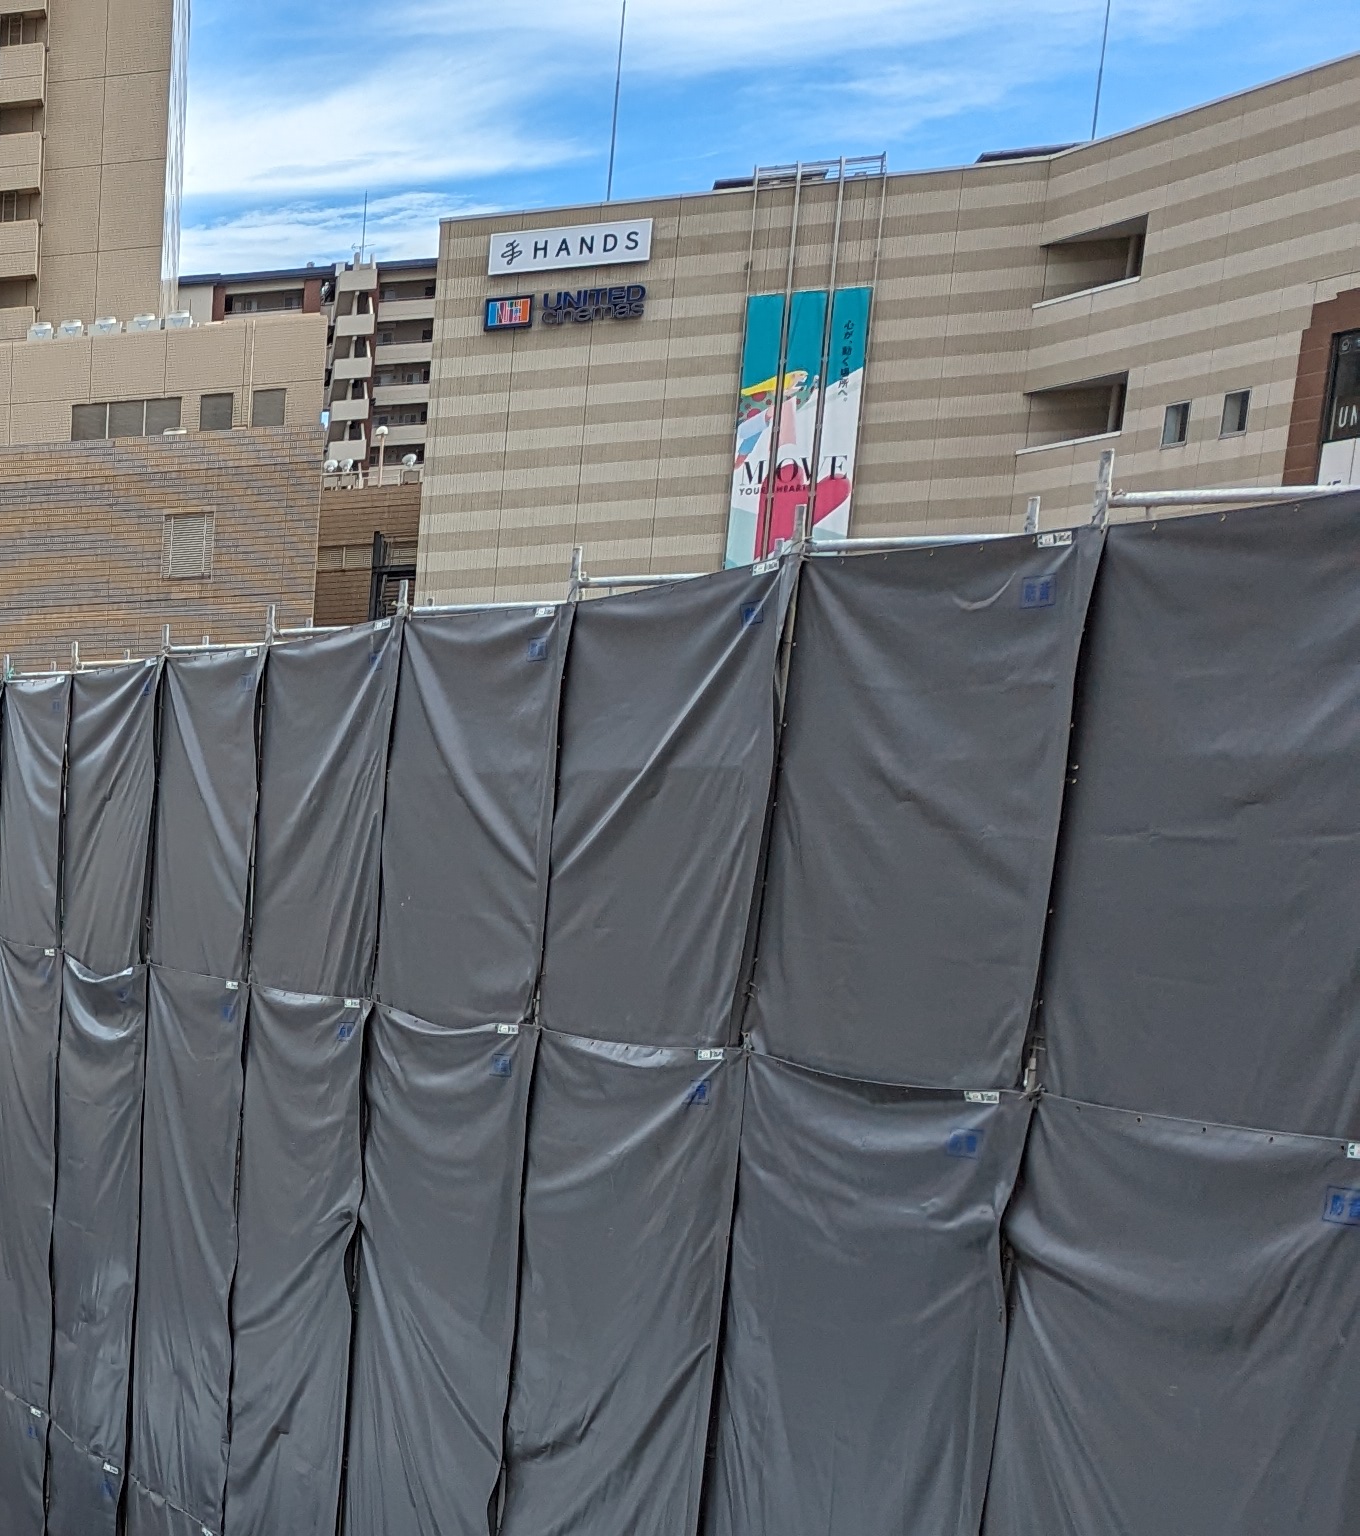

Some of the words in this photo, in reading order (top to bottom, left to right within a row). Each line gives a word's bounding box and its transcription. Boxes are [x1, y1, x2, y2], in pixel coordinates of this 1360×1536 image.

[532, 231, 640, 260] HANDS
[543, 284, 647, 311] UNITED
[541, 302, 645, 325] cinemas
[739, 455, 849, 487] MOVE
[739, 486, 767, 496] YOUR
[775, 484, 809, 494] HEART
